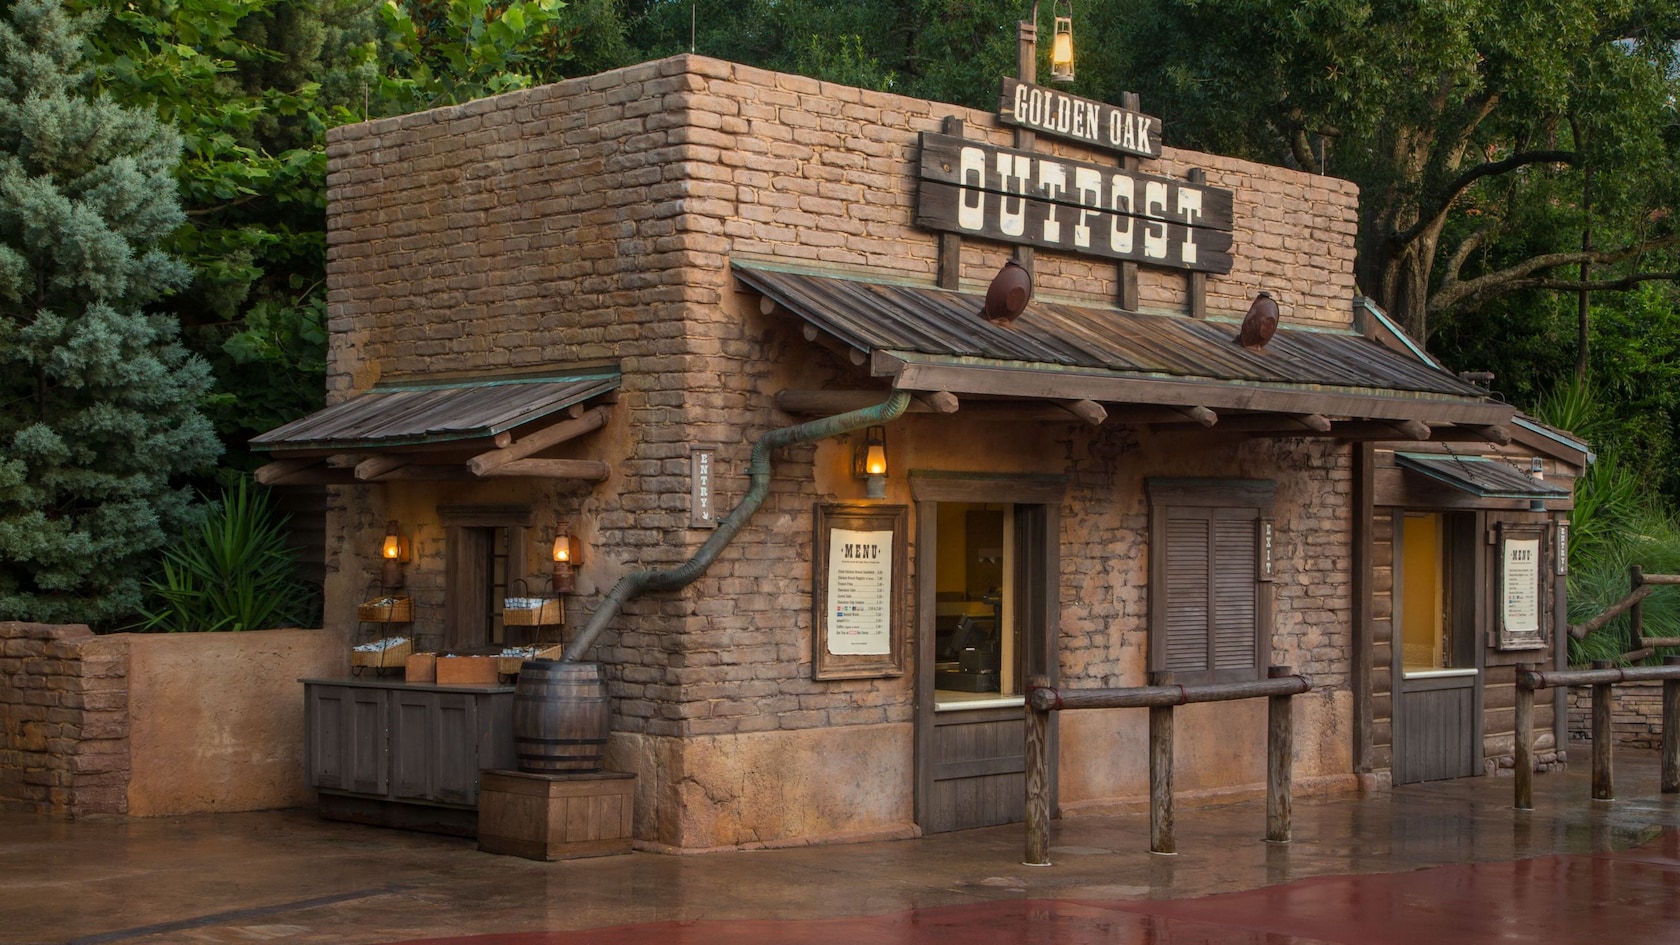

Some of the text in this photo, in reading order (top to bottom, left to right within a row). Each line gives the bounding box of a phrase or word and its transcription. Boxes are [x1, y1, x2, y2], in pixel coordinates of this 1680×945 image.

[1014, 83, 1152, 154] GOLDEN OAK
[958, 146, 1203, 263] OUTPOST
[700, 454, 708, 507] ENTRY
[844, 543, 878, 559] MENU
[1512, 549, 1531, 561] MENU
